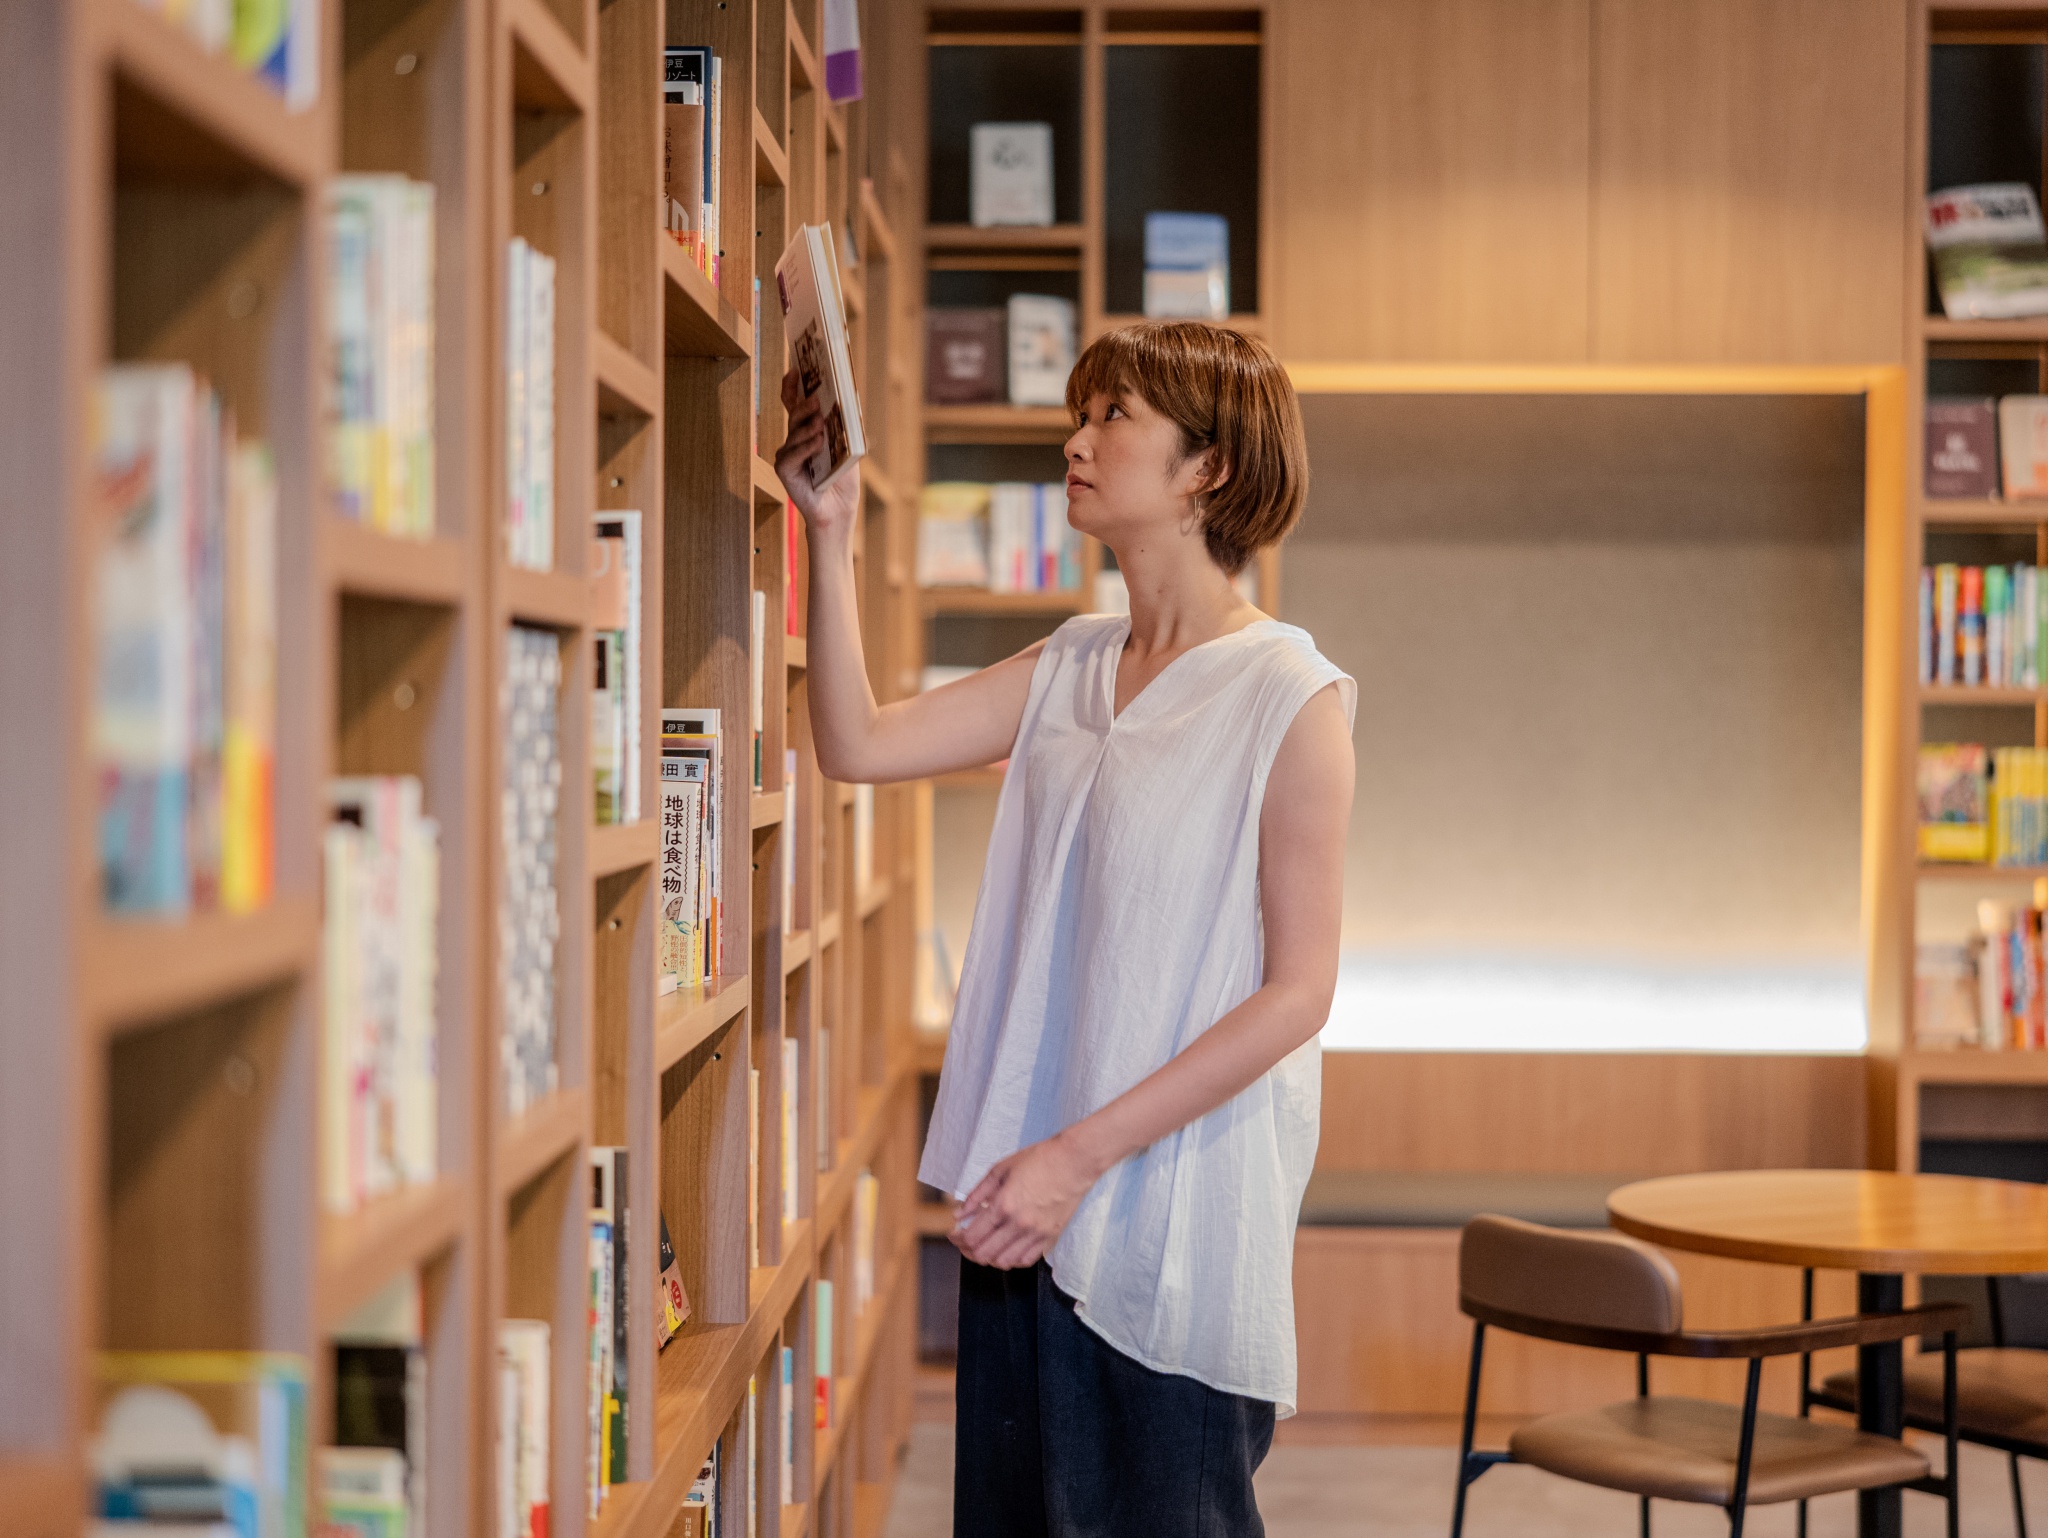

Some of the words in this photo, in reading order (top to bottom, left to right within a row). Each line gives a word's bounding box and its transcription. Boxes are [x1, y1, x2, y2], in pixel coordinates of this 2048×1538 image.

[665, 58, 684, 69] 伊豆
[665, 71, 696, 81] リゾート
[665, 723, 686, 733] 伊豆
[662, 794, 684, 894] 地球は食べ物
